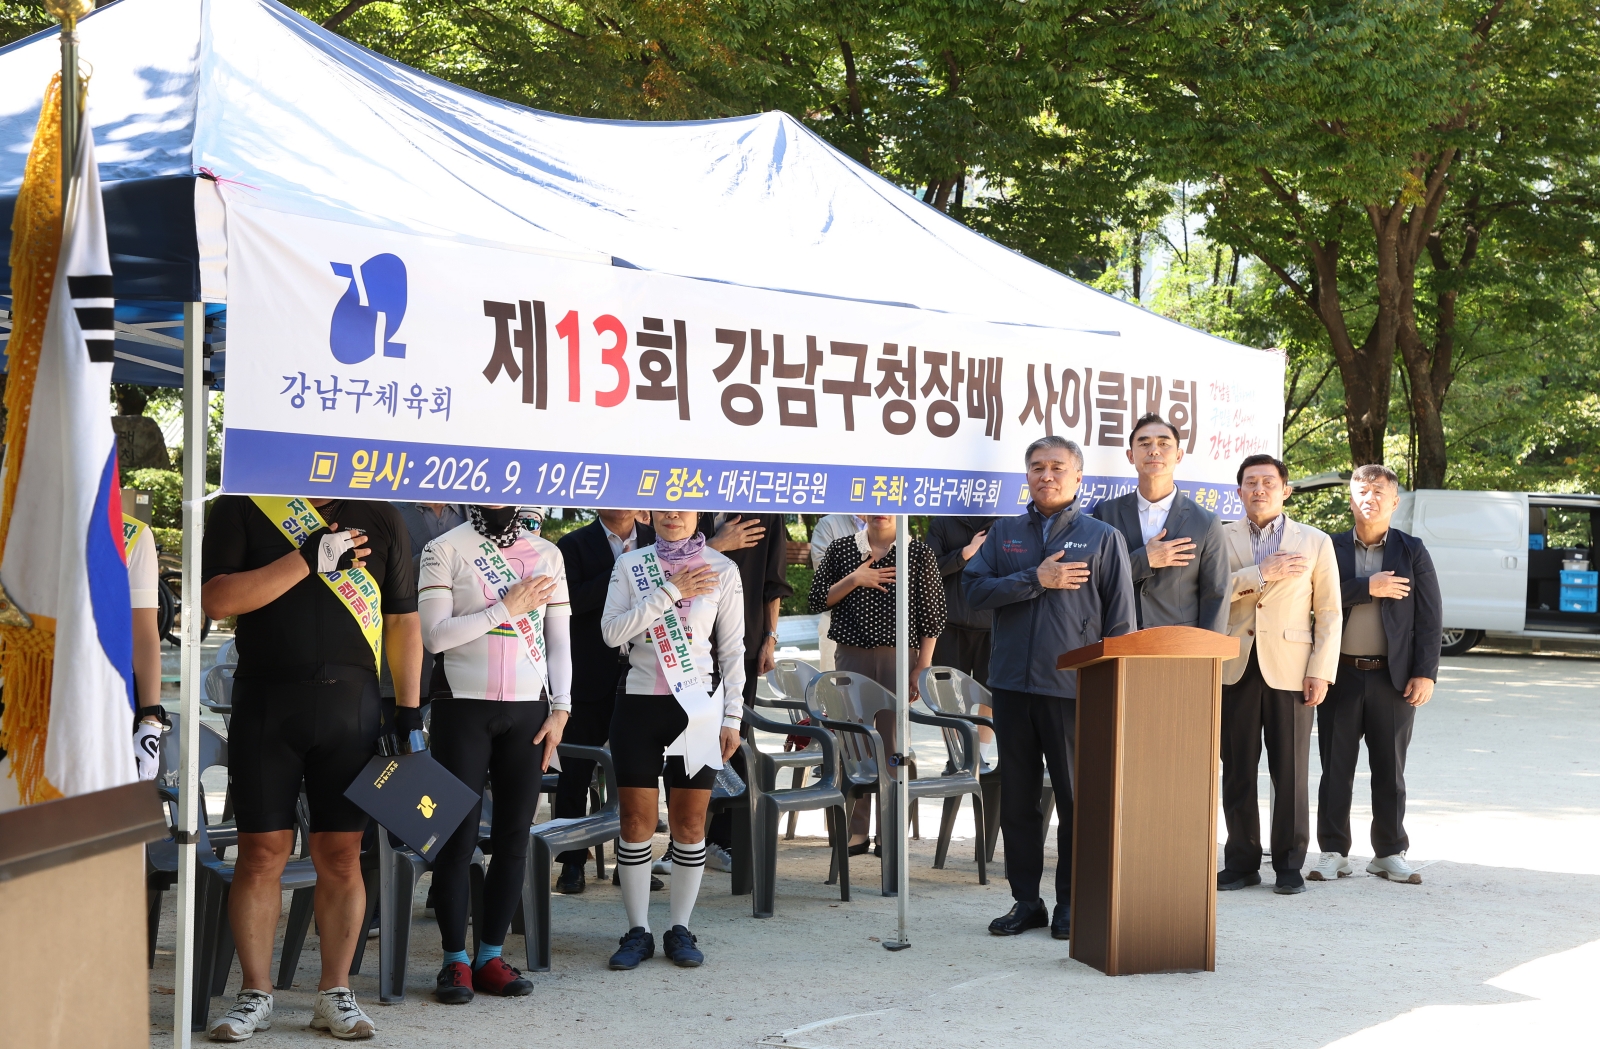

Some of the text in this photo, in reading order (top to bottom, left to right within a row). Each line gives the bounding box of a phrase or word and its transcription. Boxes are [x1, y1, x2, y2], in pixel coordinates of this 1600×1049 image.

[482, 299, 1198, 454] 제13회 강남구청장배 사이클대회
[1209, 379, 1231, 403] 강남을
[280, 371, 452, 421] 강남구체육회
[1210, 407, 1231, 428] 구민을
[1208, 431, 1232, 460] 강남
[348, 449, 414, 491] 일시:
[419, 455, 491, 494] 2026.
[504, 460, 523, 495] 9.
[665, 467, 828, 505] 장소: 대치근린공원
[871, 475, 1003, 508] 주최: 강남구체육회
[1078, 483, 1138, 509] 남구사이
[1222, 490, 1244, 515] 강남
[478, 541, 517, 582] 자전거
[642, 552, 664, 588] 자전거
[337, 581, 370, 629] 캠페인
[653, 624, 677, 669] 캠페인
